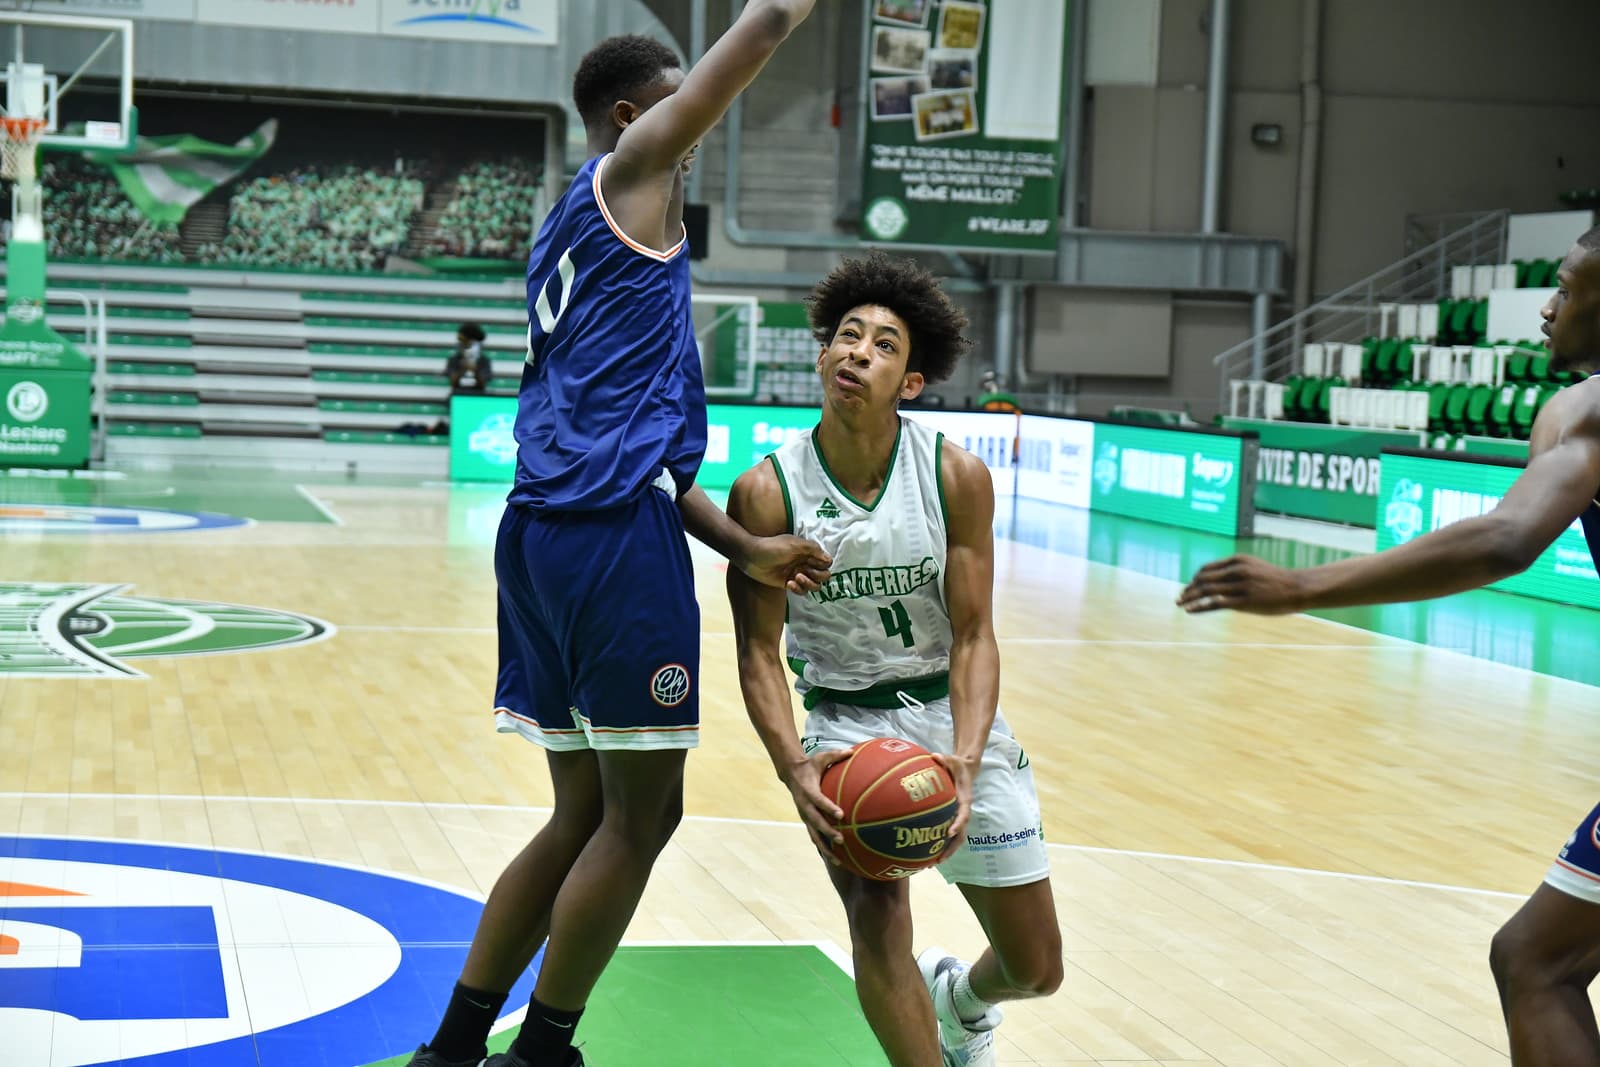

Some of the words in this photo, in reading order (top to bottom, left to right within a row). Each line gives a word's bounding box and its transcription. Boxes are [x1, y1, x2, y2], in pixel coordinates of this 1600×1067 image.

[905, 184, 948, 201] MÊME
[1297, 451, 1325, 490] DE
[816, 509, 841, 519] PEAK
[878, 599, 915, 648] 4
